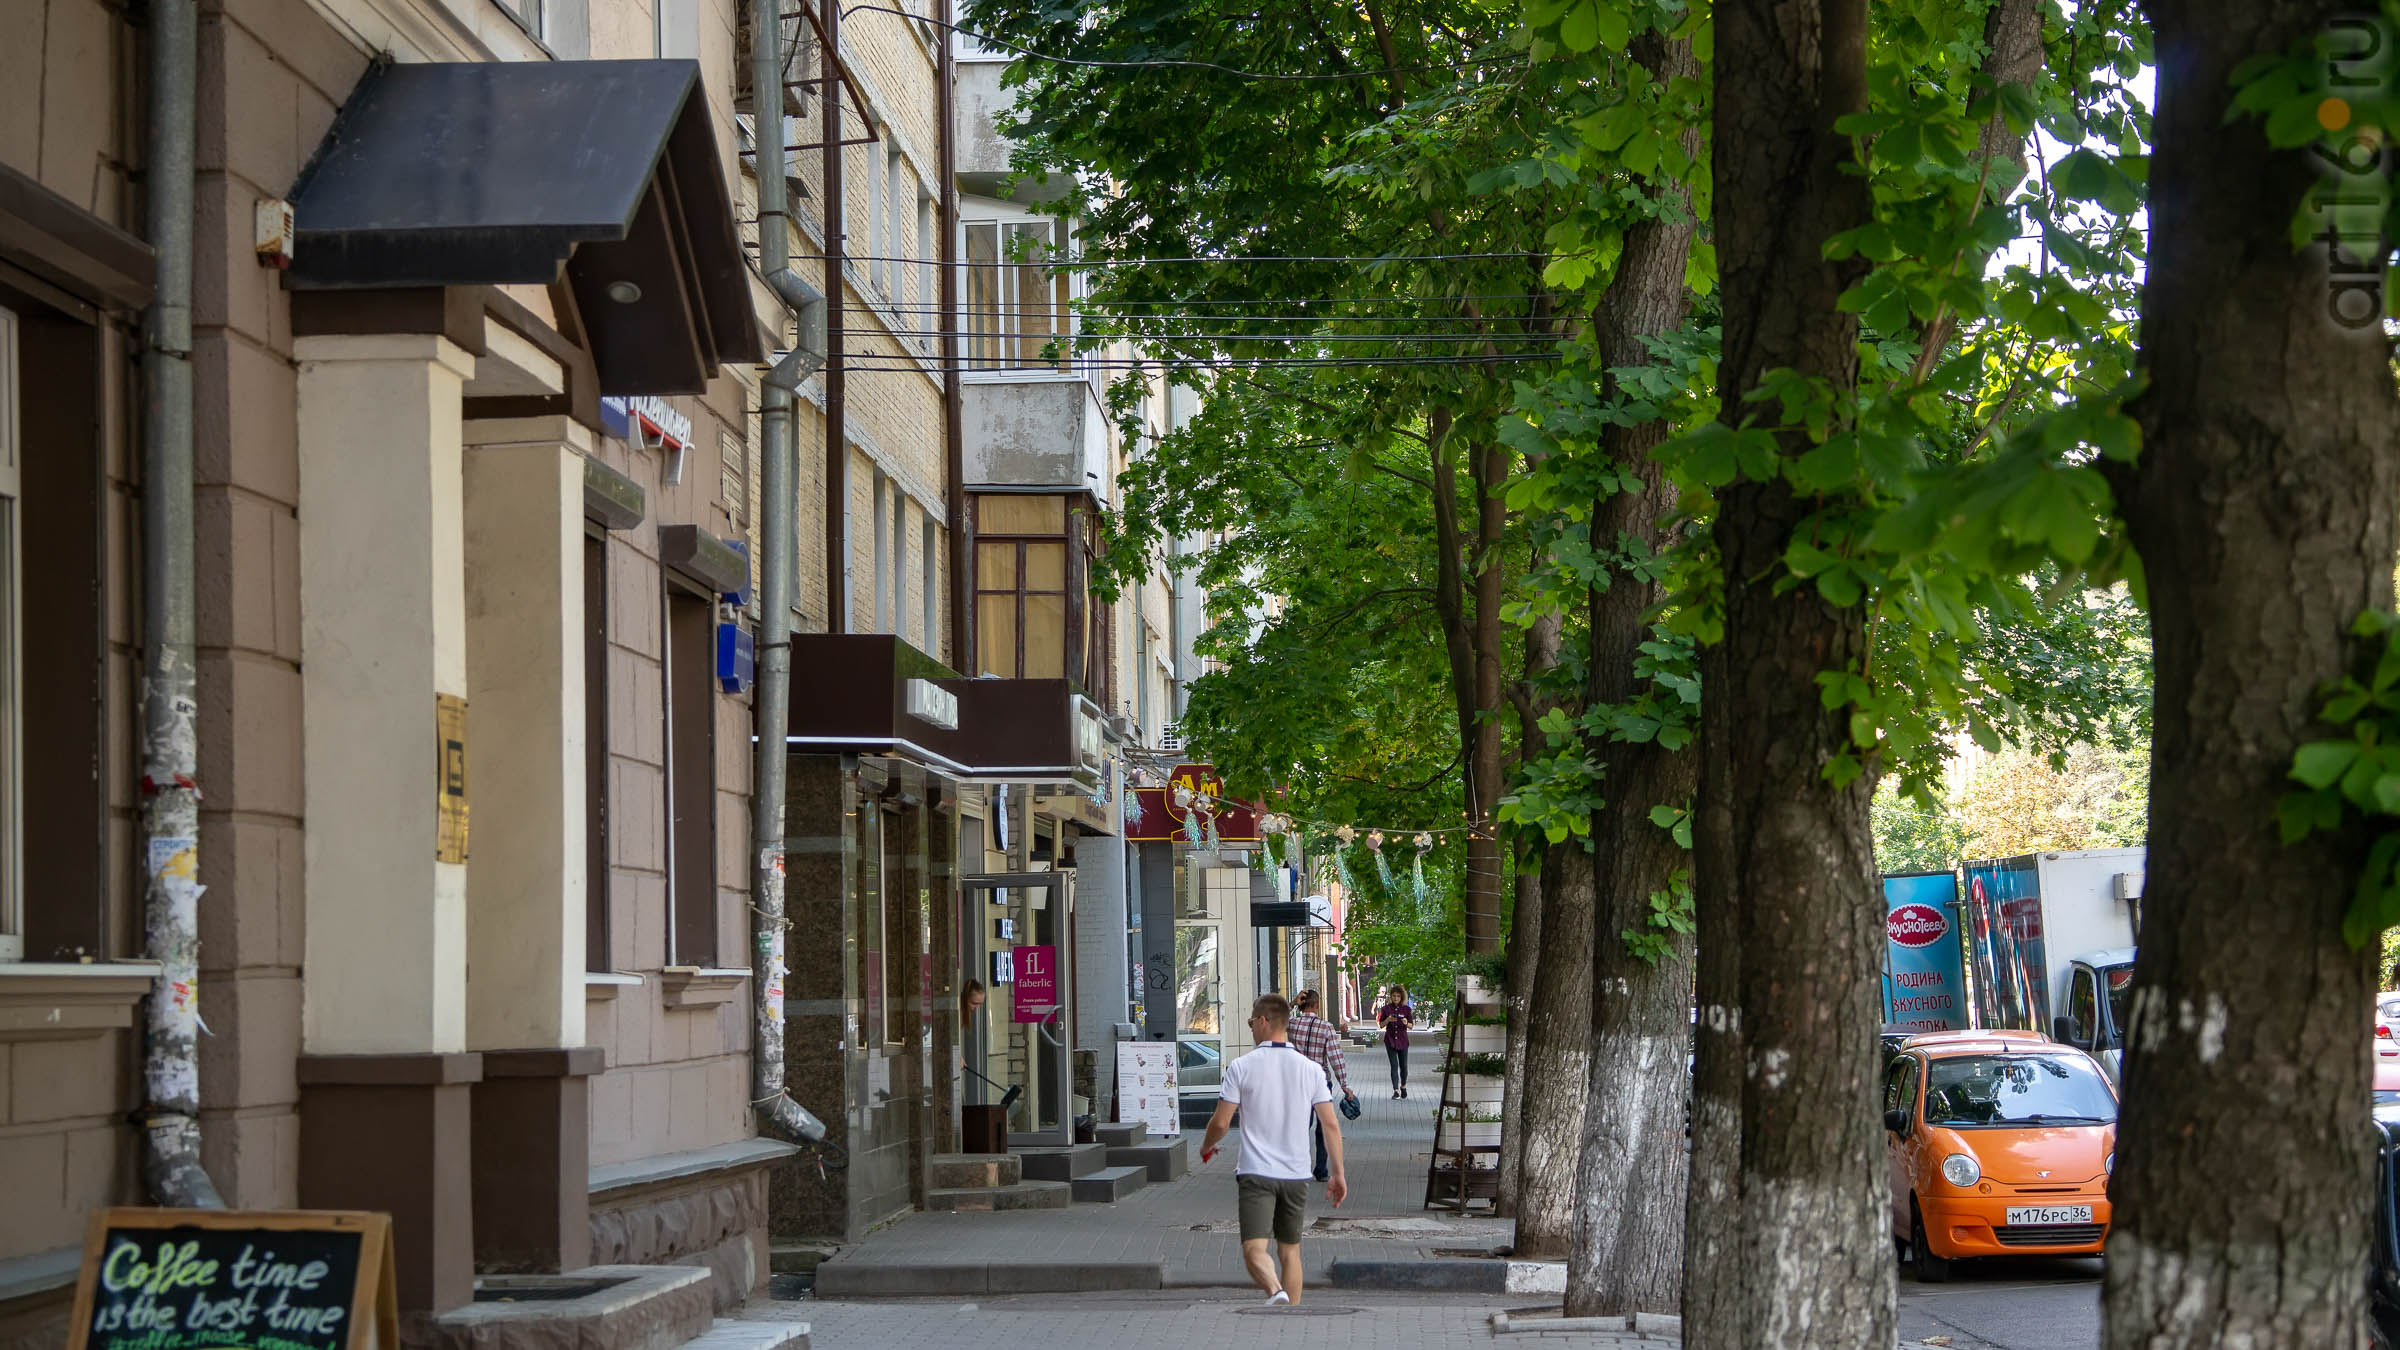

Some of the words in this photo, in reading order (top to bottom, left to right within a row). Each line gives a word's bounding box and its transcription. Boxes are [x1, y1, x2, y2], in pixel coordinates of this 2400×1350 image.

[1018, 978, 1053, 988] faberlic
[1896, 972, 1944, 988] РОДИНА
[2072, 1207, 2087, 1218] 36
[103, 1240, 219, 1294] Coffee
[232, 1244, 329, 1290] time
[95, 1304, 126, 1332] is
[126, 1294, 178, 1331] the
[186, 1292, 259, 1331] best
[264, 1290, 345, 1334] time
